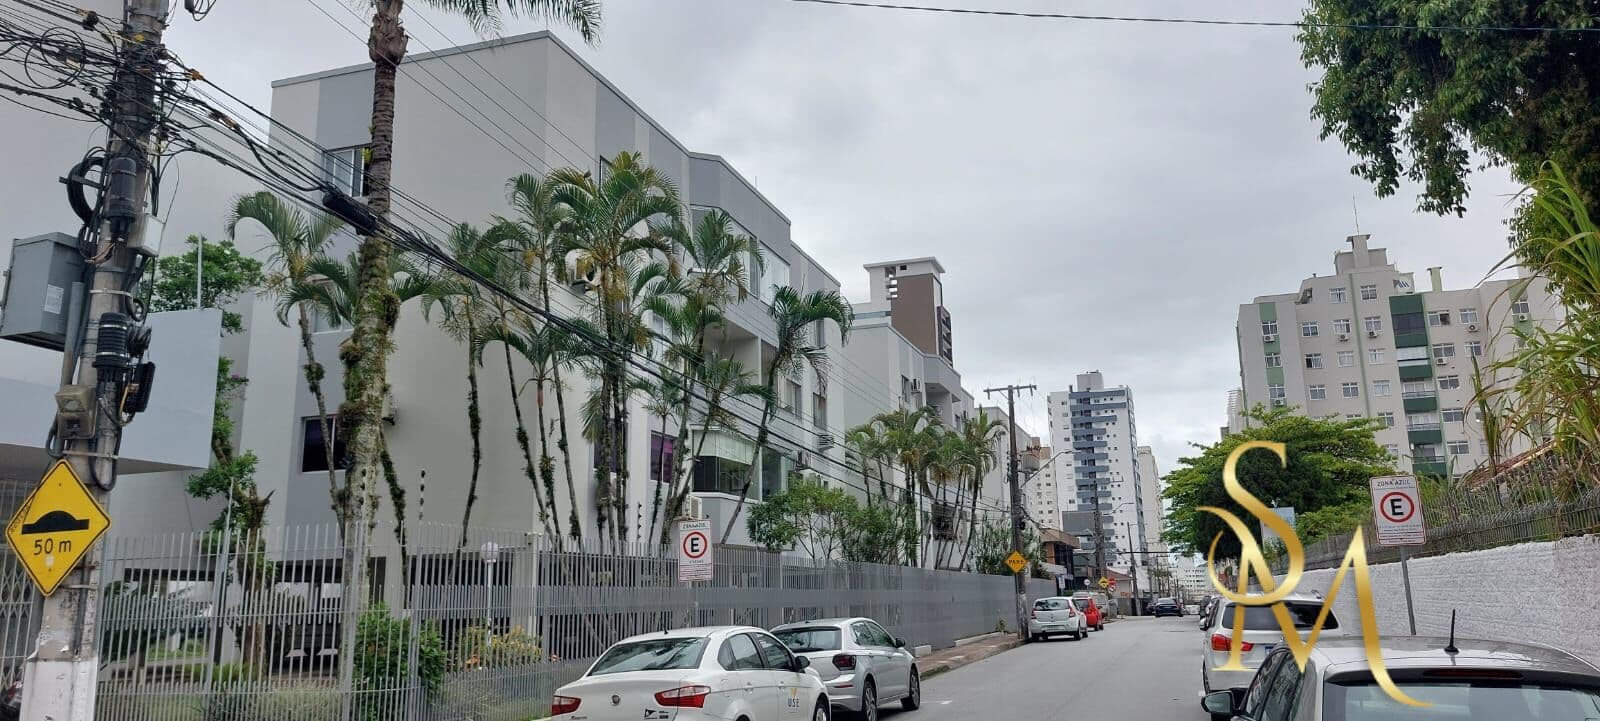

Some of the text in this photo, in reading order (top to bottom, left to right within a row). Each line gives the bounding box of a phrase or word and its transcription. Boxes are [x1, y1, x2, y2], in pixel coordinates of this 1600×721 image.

[1390, 498, 1404, 516] E
[33, 538, 72, 556] 50 m
[690, 537, 700, 553] E
